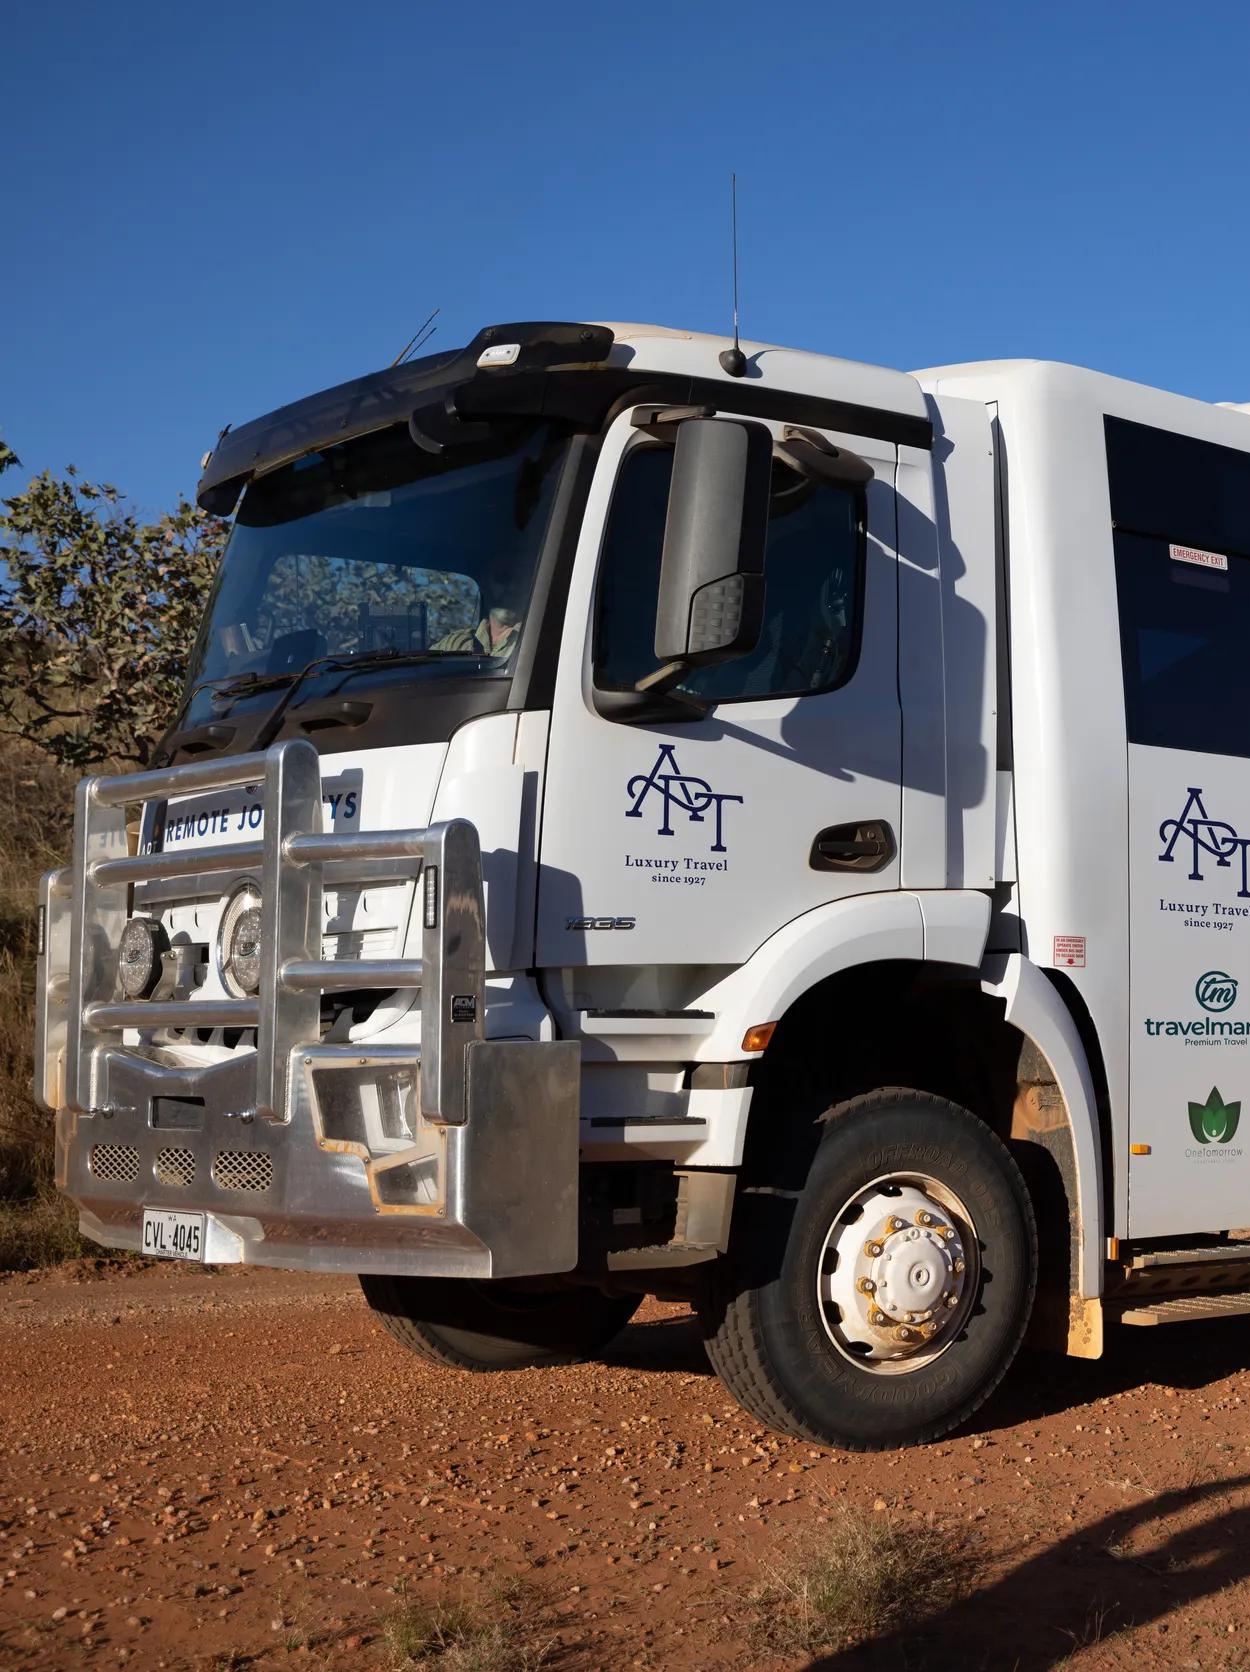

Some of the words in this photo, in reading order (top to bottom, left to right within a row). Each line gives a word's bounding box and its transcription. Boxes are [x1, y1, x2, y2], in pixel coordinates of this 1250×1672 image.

[1172, 548, 1209, 563] EMERGENCY
[1210, 556, 1224, 566] EXIT
[625, 744, 744, 852] APT
[166, 808, 230, 843] REMOTE
[625, 855, 679, 871] Luxury
[683, 858, 728, 871] Travel
[651, 873, 681, 883] since
[684, 876, 706, 886] 1927
[1159, 899, 1208, 917] Luxury
[1184, 918, 1211, 929] since
[1213, 921, 1234, 931] 1927
[1185, 1038, 1222, 1047] Premium
[1224, 1037, 1248, 1046] Travel
